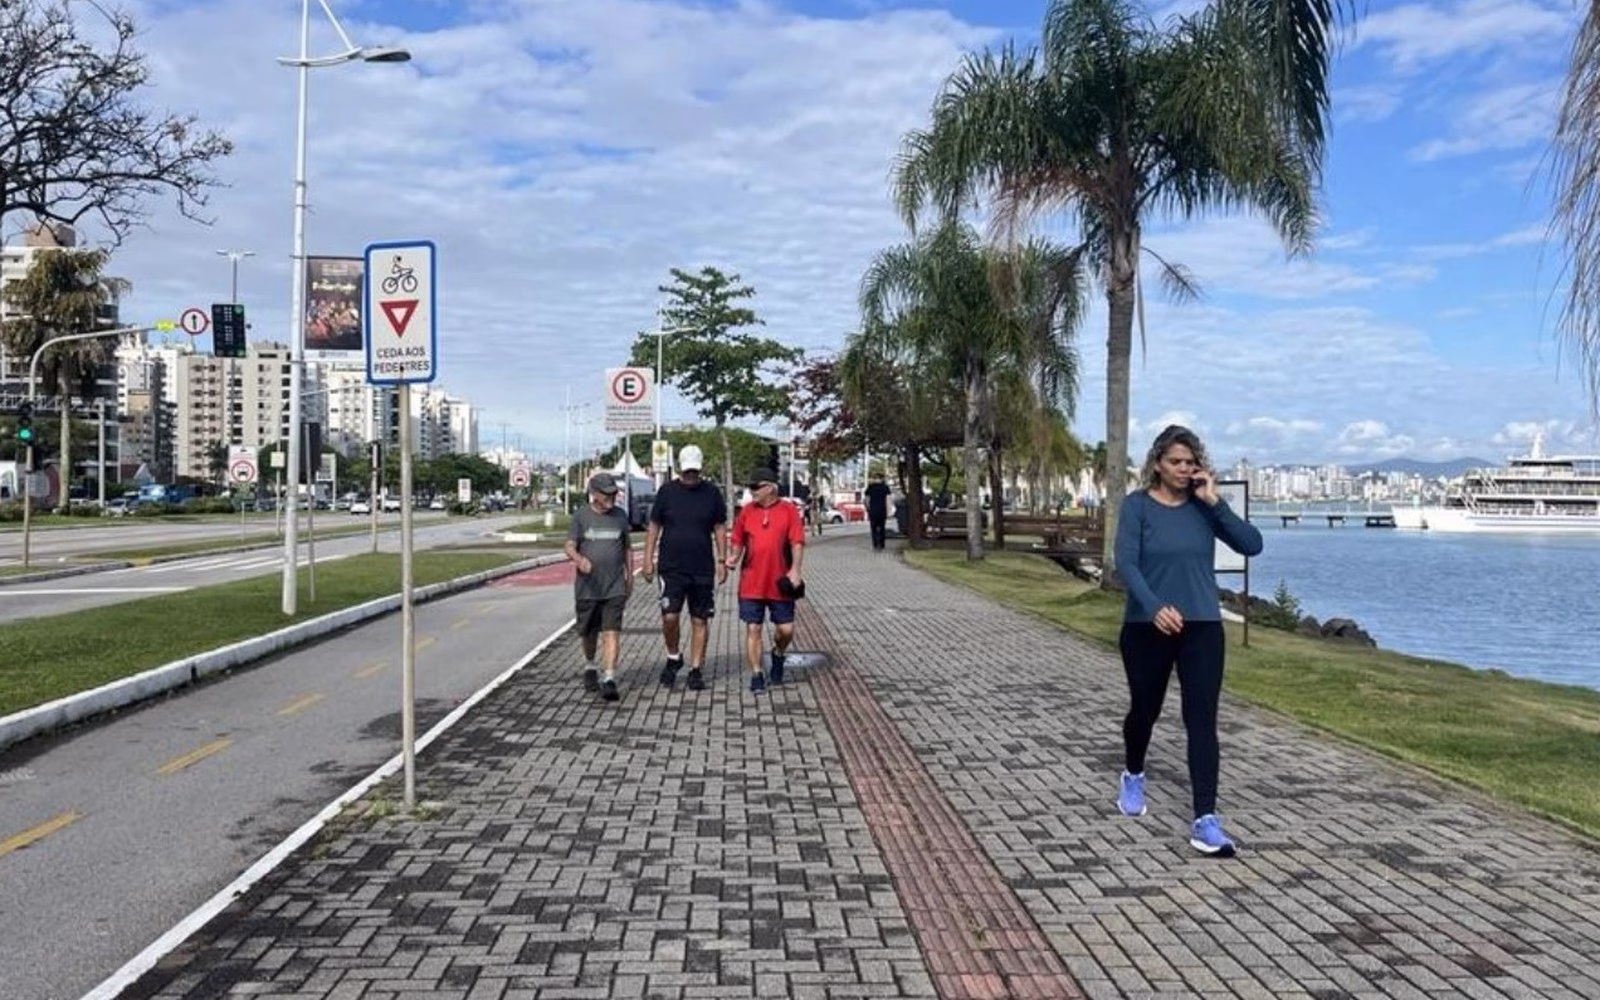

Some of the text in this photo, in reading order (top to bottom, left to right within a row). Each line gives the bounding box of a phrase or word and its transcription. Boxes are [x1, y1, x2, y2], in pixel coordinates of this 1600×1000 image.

[376, 345, 426, 358] CEDA AOS
[623, 377, 635, 396] E
